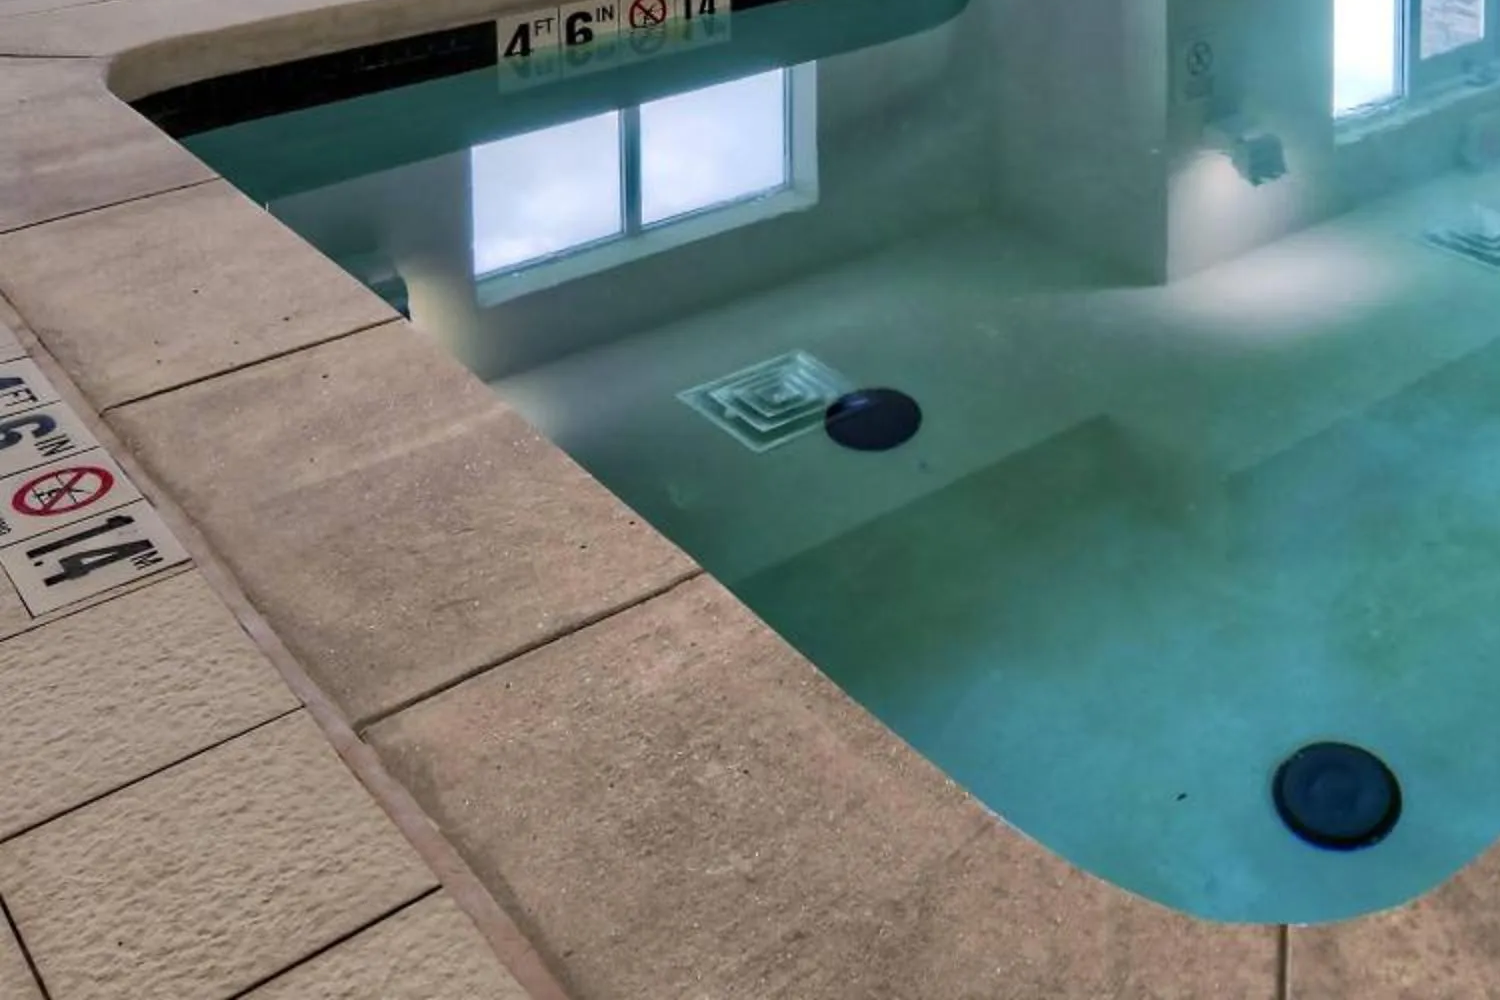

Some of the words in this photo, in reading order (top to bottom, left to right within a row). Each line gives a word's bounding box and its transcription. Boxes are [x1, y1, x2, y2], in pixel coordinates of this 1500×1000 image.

[504, 22, 533, 57] 4
[535, 18, 554, 36] FT
[566, 11, 593, 46] 6
[597, 4, 615, 22] IN
[34, 433, 75, 457] IN
